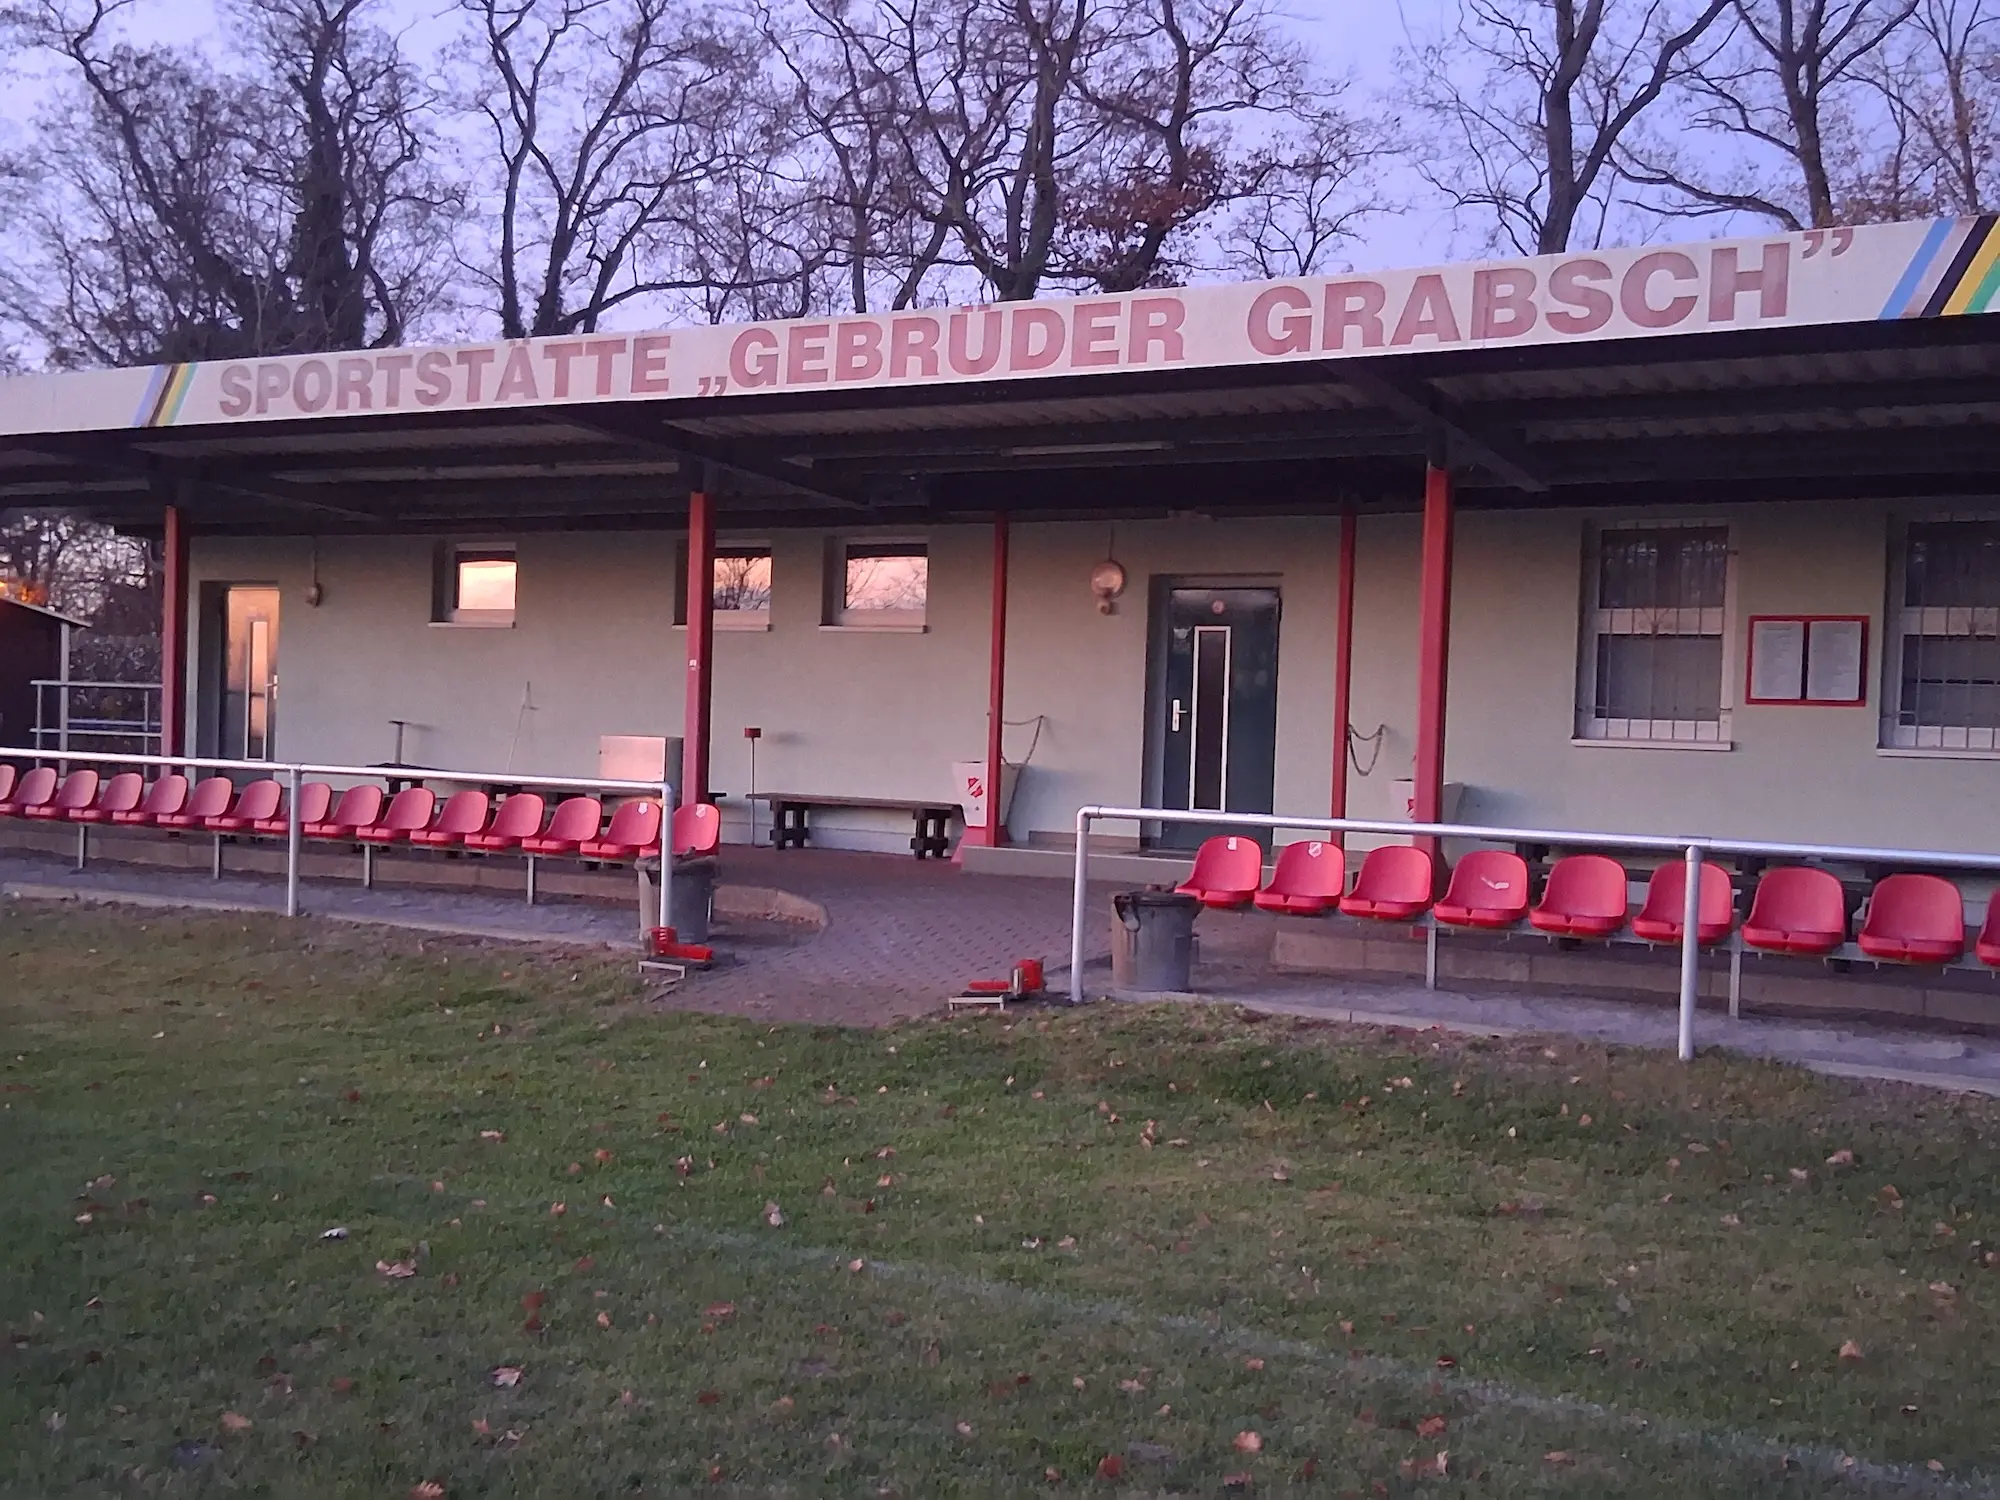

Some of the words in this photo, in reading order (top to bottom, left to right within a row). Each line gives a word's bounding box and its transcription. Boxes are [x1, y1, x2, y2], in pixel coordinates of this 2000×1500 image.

[219, 335, 671, 417] SPORTSTÄTTE
[698, 297, 1185, 397] „GEBRÜDER
[1247, 228, 1853, 356] GRABSCH”
